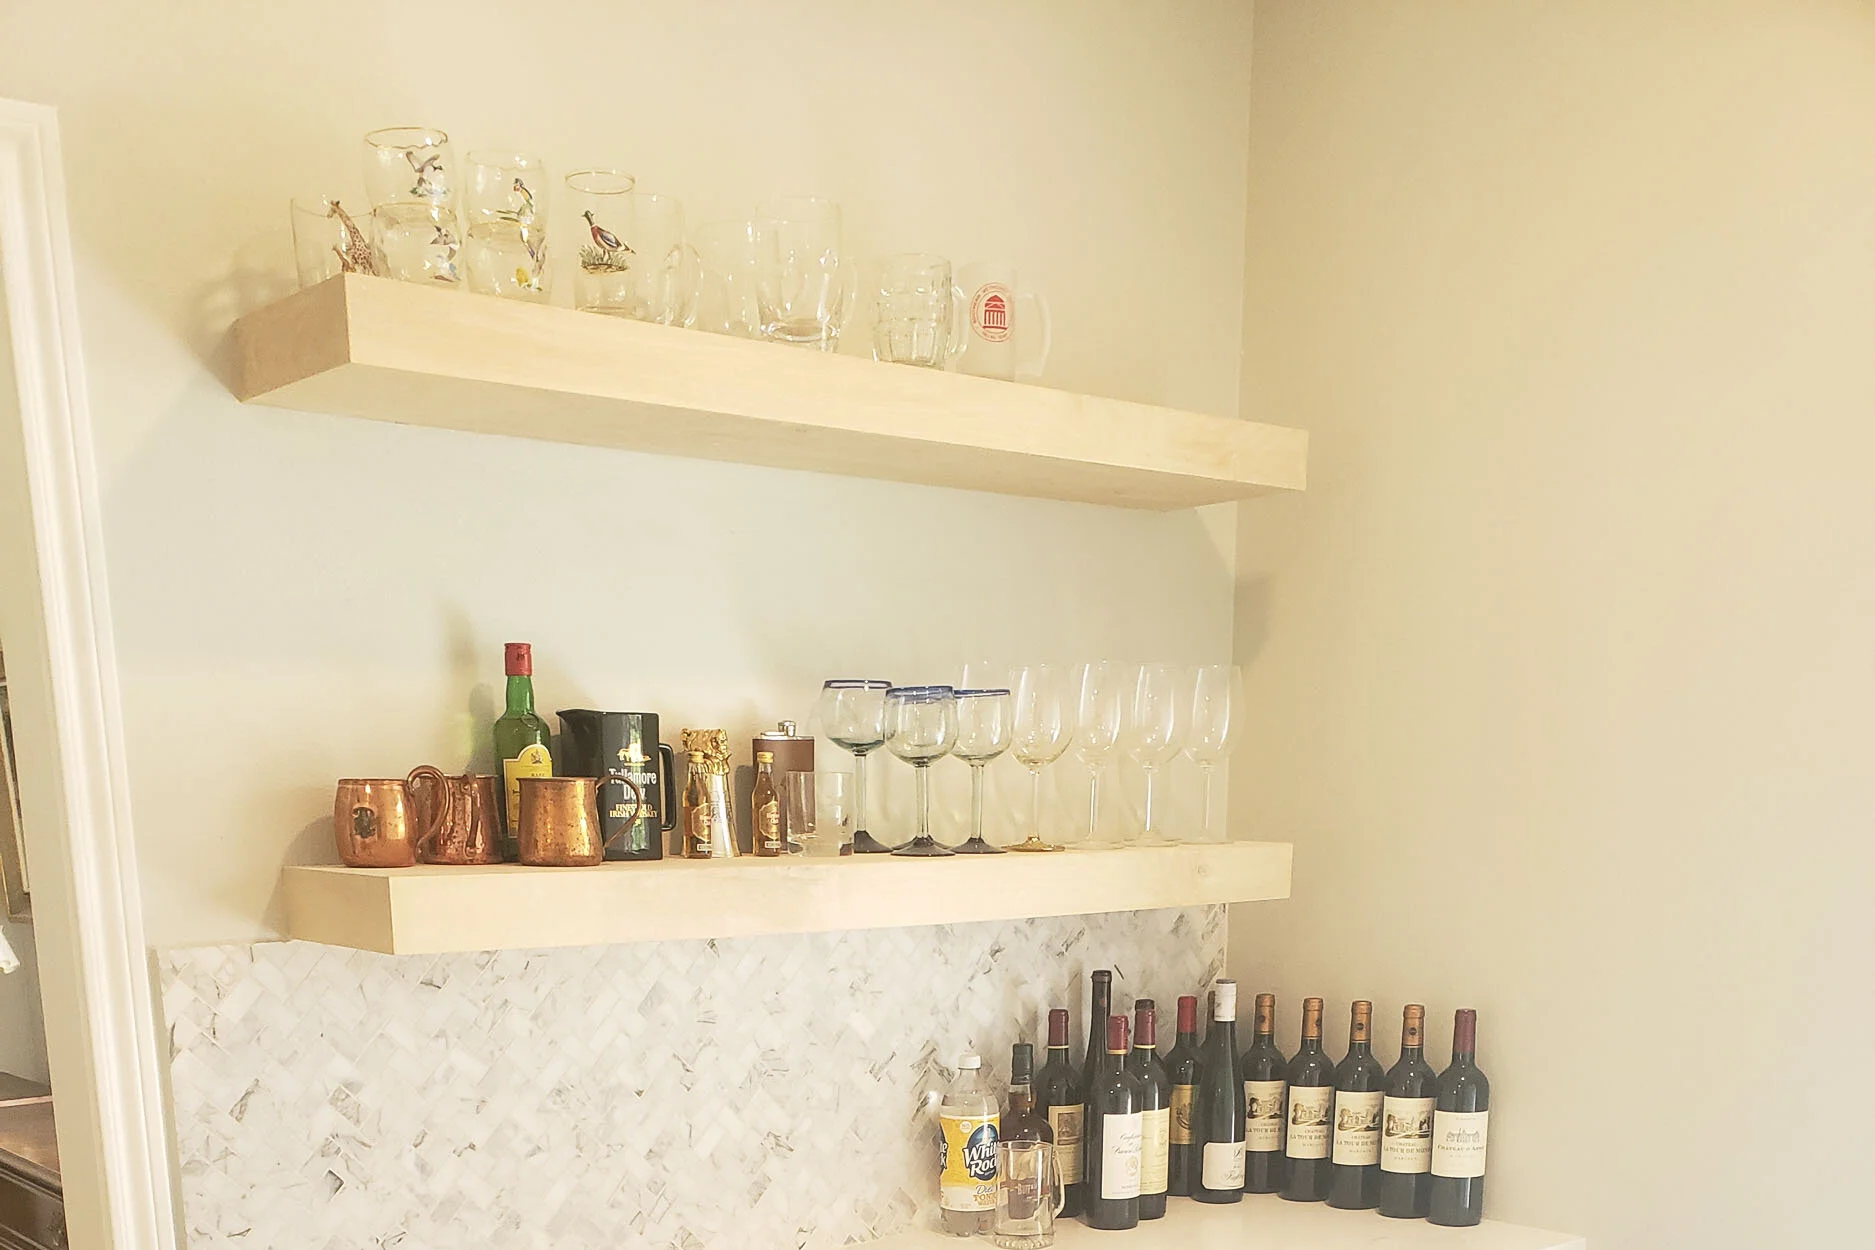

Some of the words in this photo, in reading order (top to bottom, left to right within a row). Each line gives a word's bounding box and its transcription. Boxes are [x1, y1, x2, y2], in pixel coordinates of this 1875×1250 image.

[608, 767, 657, 785] Tullamore
[963, 1141, 997, 1168] Whit
[970, 1154, 997, 1177] Roc
[975, 1184, 993, 1195] Die
